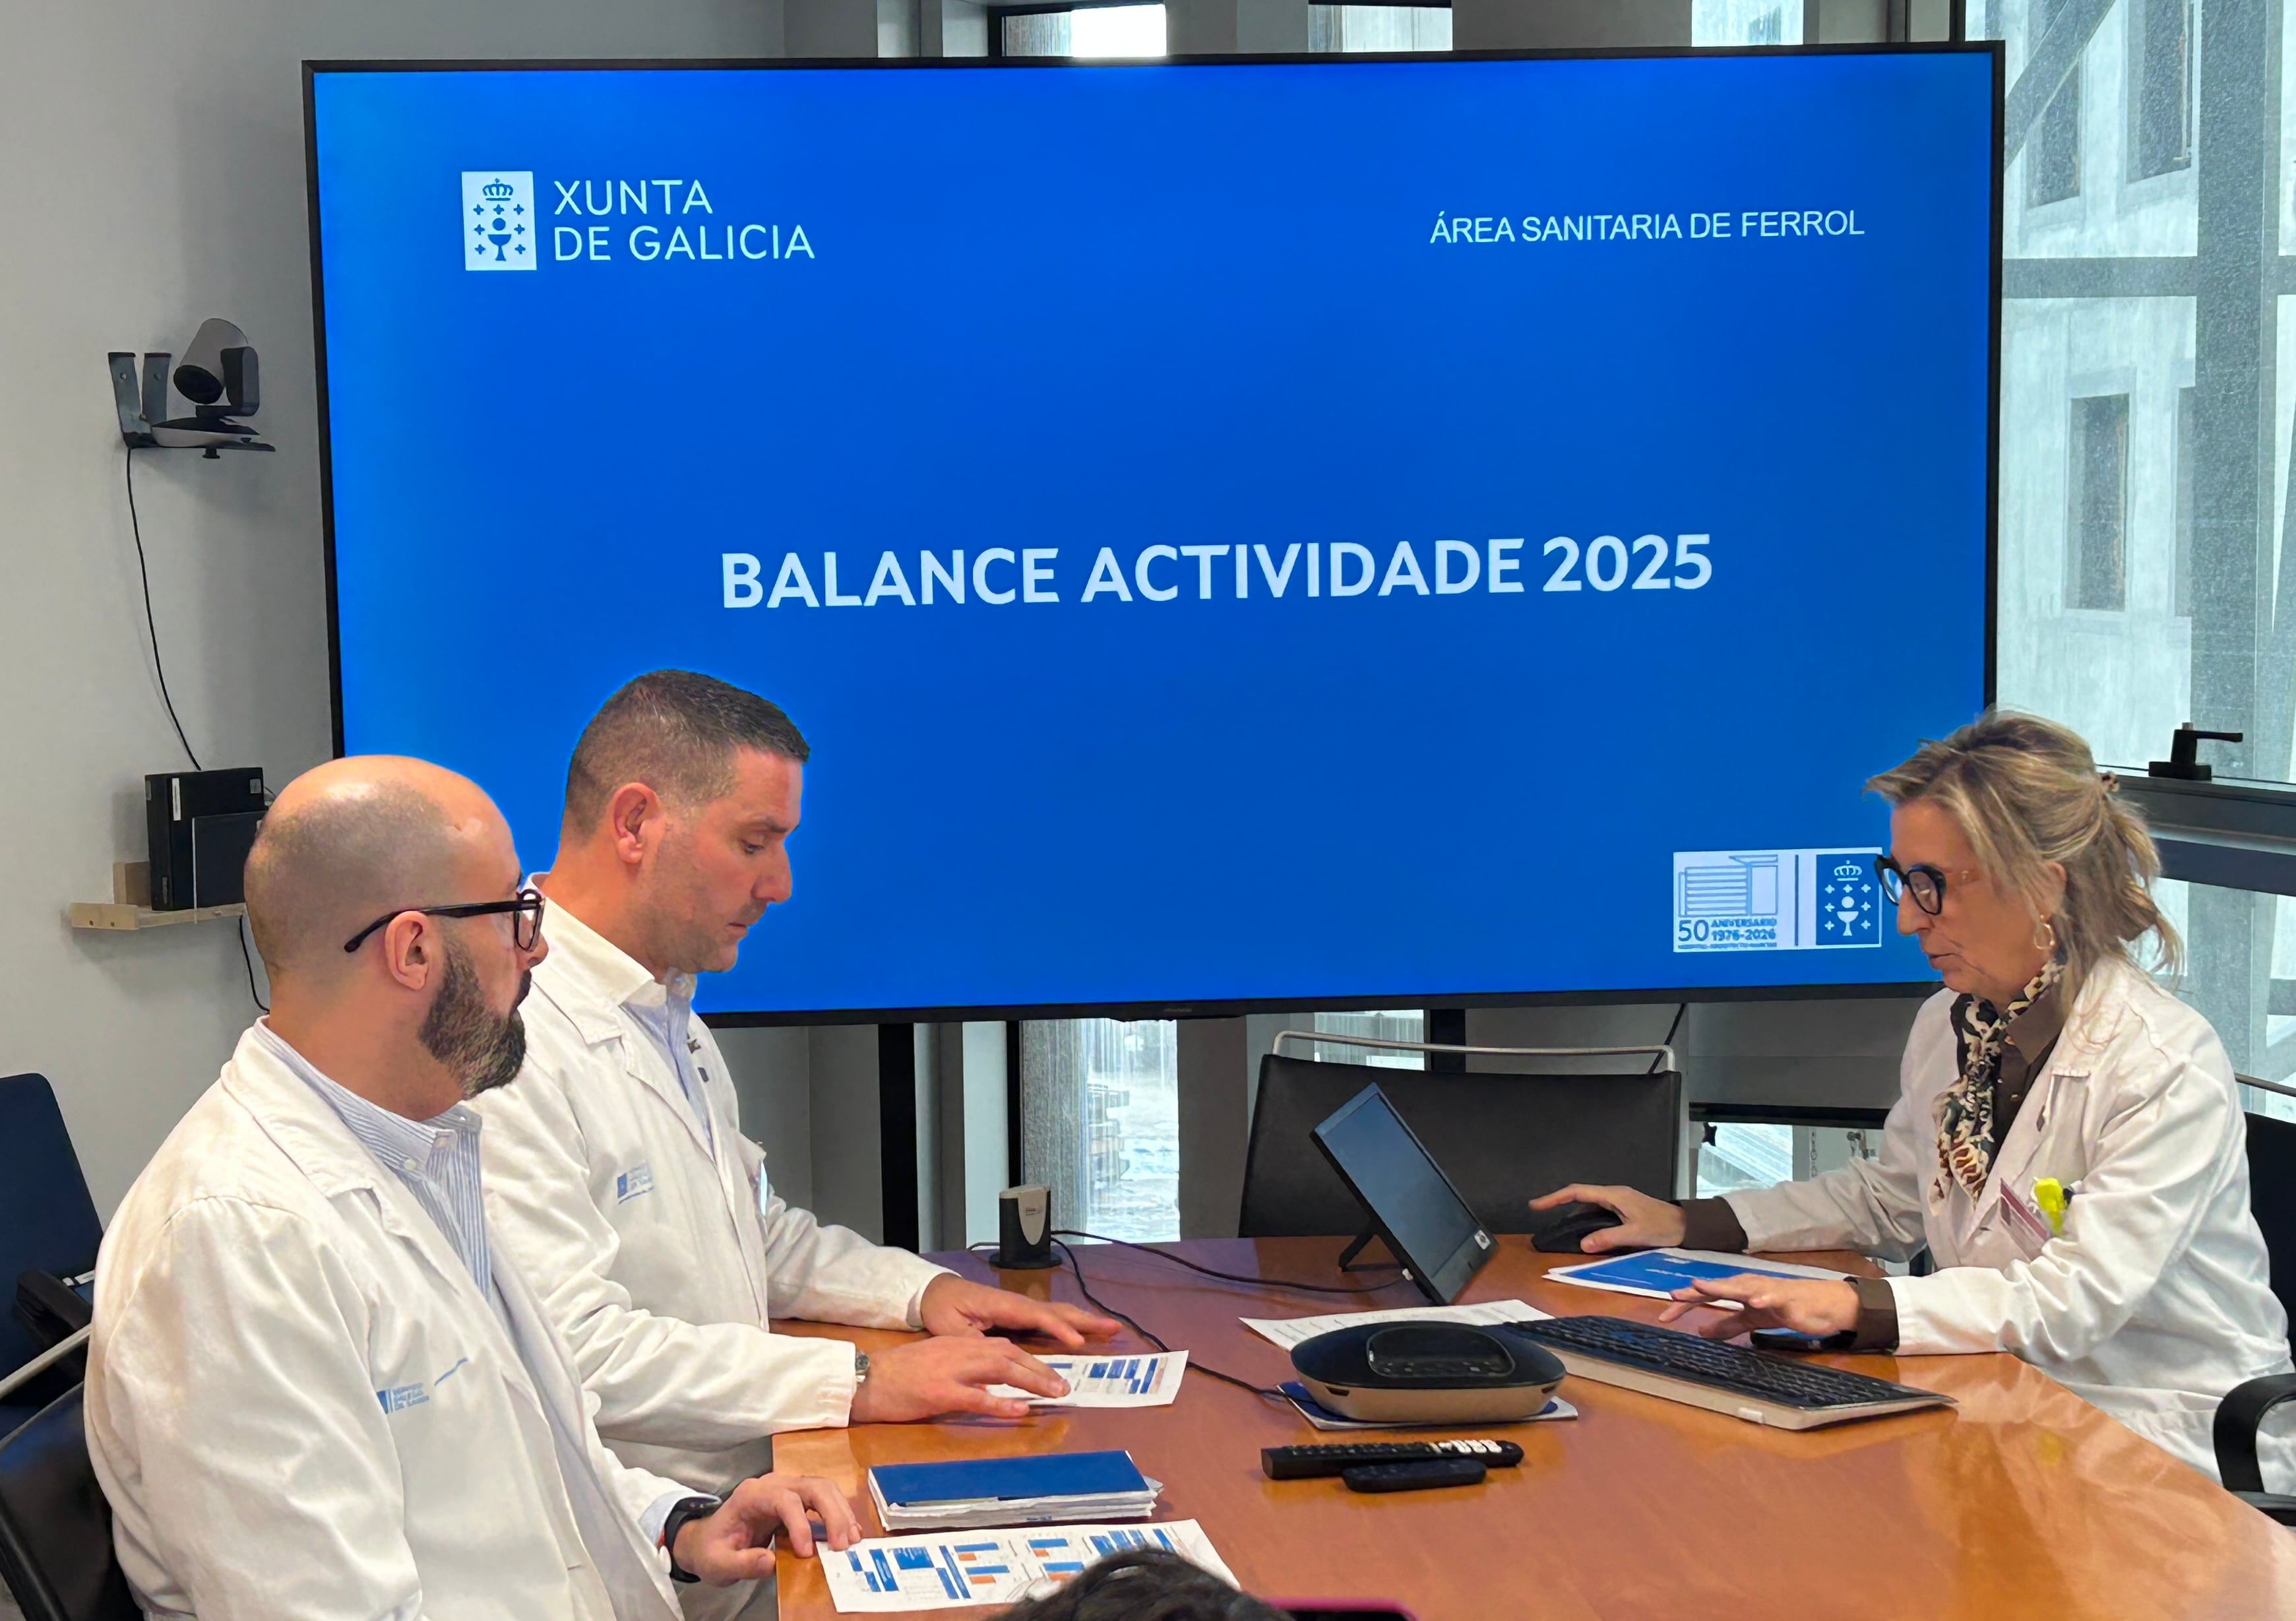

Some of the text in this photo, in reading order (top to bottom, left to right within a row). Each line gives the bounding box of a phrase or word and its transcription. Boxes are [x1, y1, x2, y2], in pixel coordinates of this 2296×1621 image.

[554, 179, 713, 216] XUNTA
[554, 224, 815, 261] DE GALICIA
[1430, 210, 1865, 243] ÁREA SANITARIA DE FERROL
[722, 534, 1712, 608] BALANCE ACTIVIDADE 2025
[1678, 920, 1709, 941] 50
[1712, 929, 1776, 941] 1976-2026
